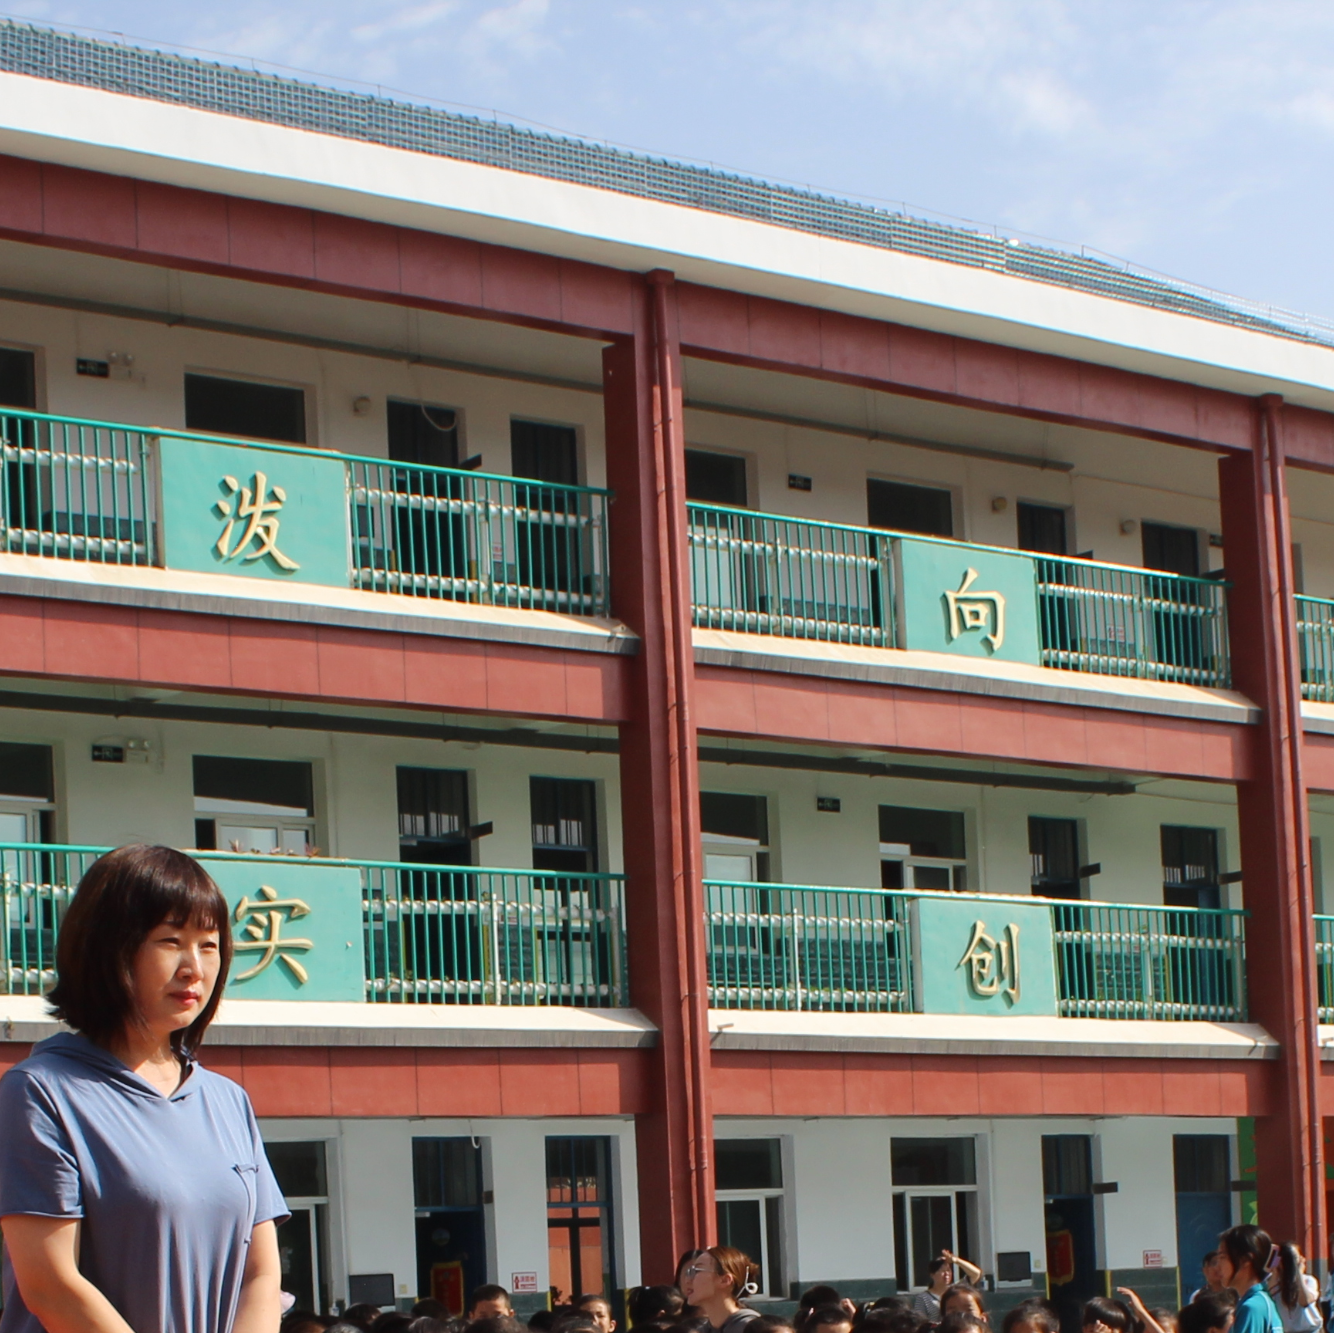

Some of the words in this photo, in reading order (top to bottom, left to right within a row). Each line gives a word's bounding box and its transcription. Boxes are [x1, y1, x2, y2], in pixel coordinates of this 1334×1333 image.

[216, 470, 300, 572] 泼
[942, 567, 1008, 653] 向
[233, 885, 314, 985] 实
[958, 920, 1021, 1006] 创
